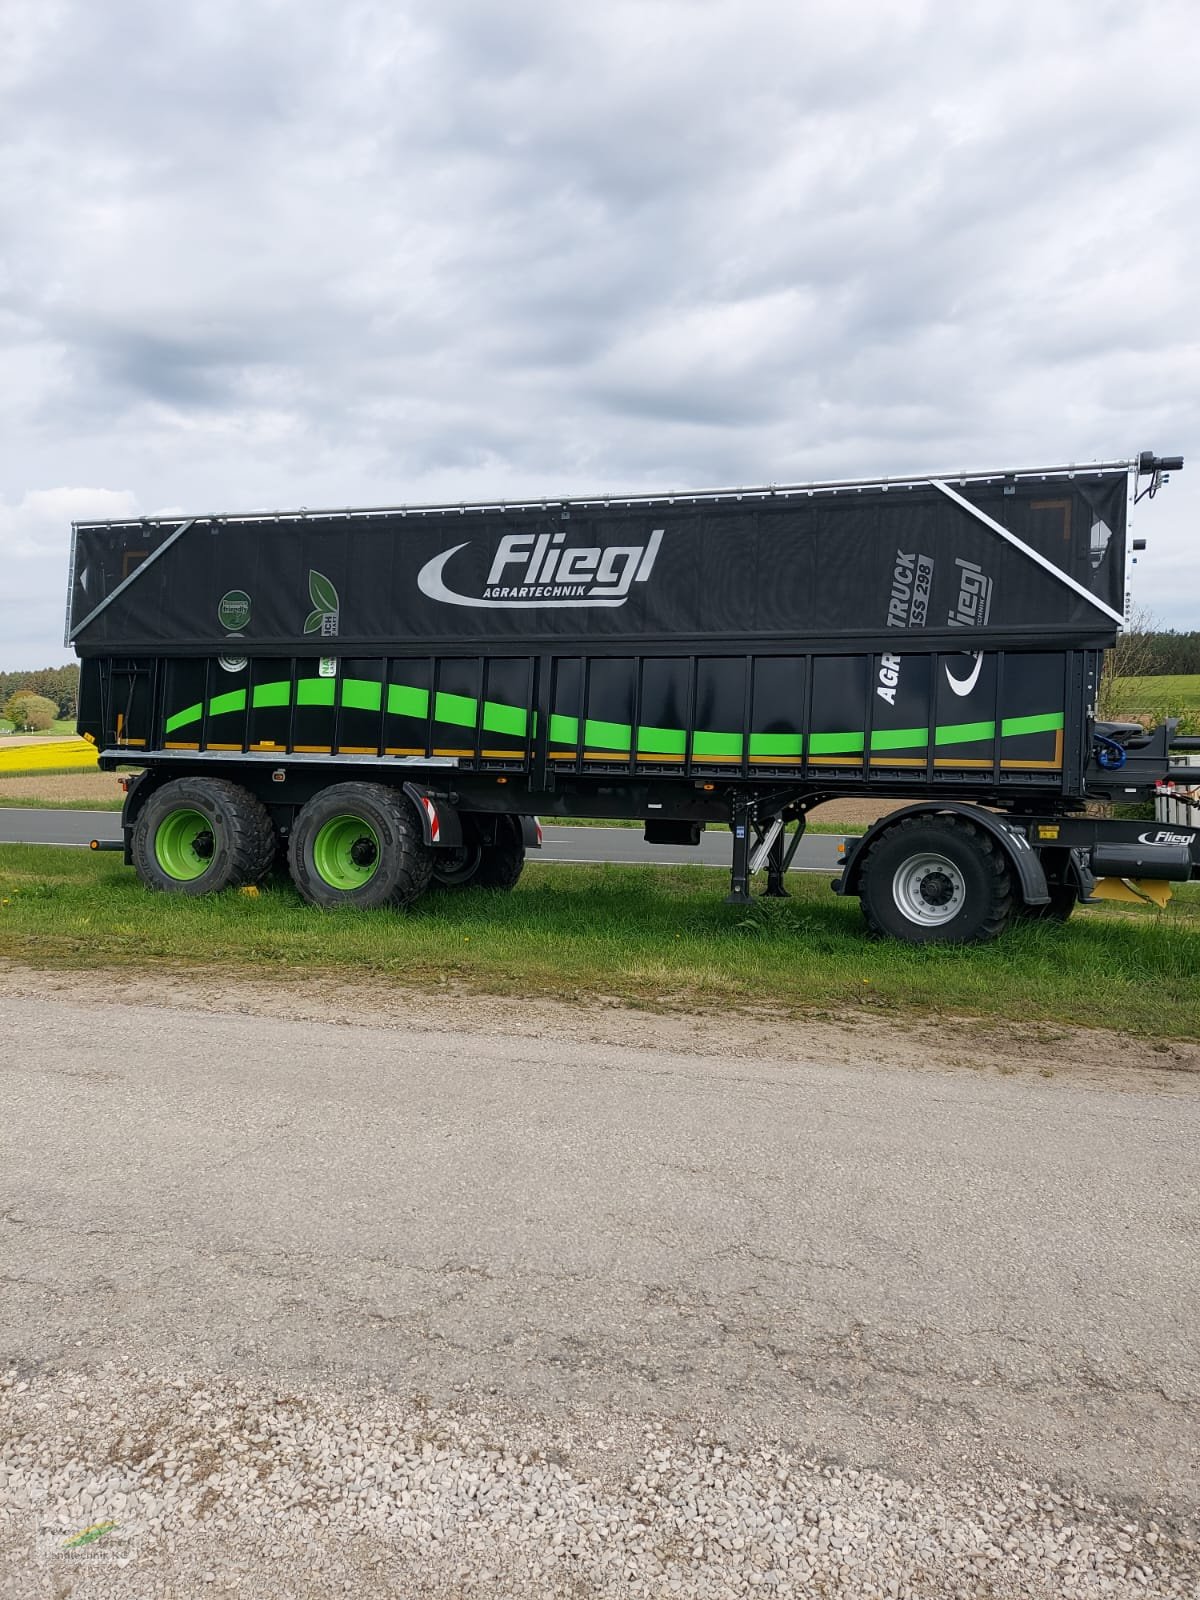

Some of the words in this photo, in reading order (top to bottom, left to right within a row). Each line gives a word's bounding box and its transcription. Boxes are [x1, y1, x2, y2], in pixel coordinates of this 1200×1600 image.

[486, 529, 665, 596] Fliegl
[482, 584, 587, 599] AGRARTECHNIK
[886, 549, 916, 628] TRUCK
[917, 563, 931, 597] 298
[1155, 831, 1196, 844] Fliegl
